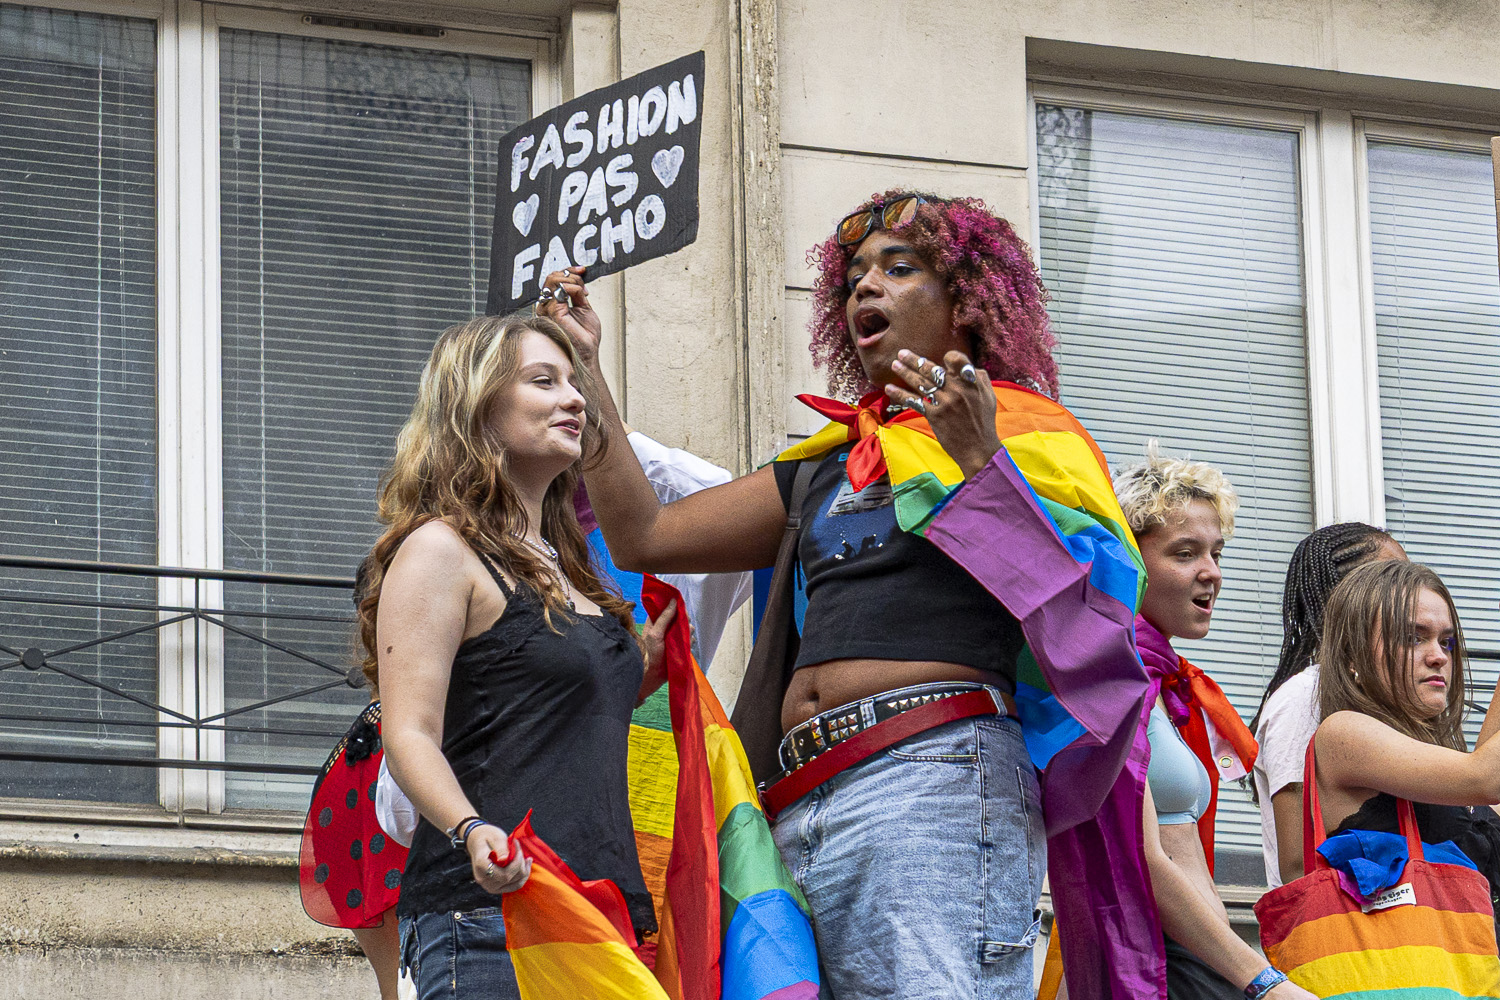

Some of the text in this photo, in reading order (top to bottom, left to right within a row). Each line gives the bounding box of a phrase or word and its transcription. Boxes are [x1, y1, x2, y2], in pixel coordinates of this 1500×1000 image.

[510, 74, 697, 192] FASHION
[558, 153, 639, 225] PAS
[511, 194, 666, 299] FACHO
